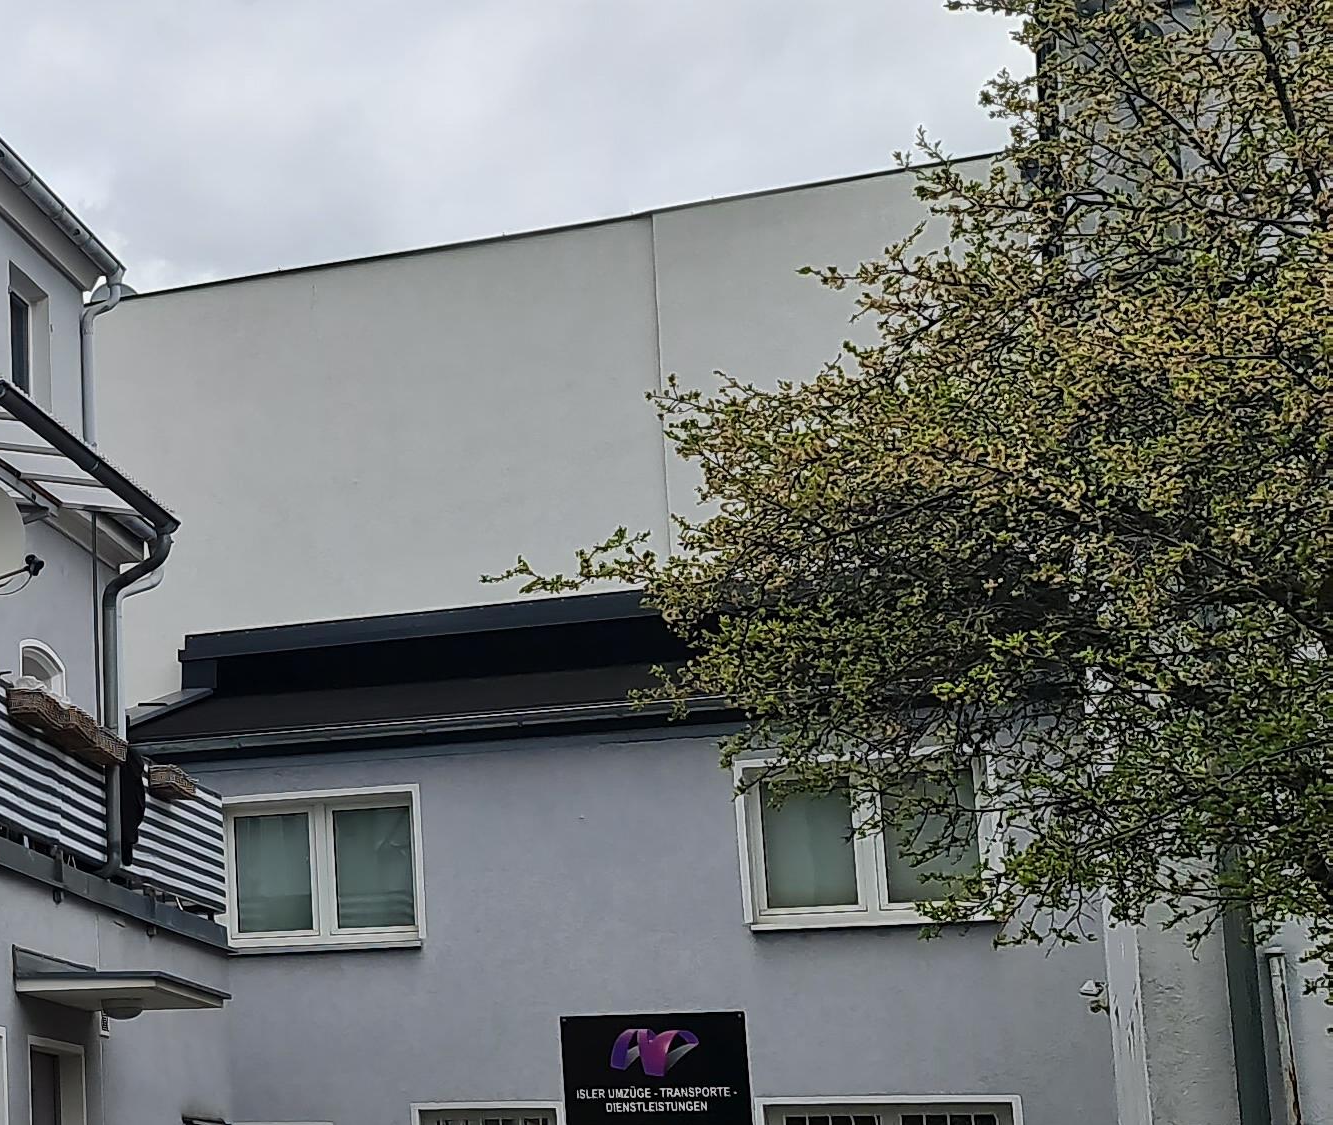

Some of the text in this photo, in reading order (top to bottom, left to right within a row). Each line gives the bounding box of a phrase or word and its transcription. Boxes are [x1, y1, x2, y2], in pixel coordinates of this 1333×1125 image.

[577, 1089, 605, 1099] ISLER
[608, 1086, 651, 1098] UMZÜGE
[659, 1087, 731, 1098] TRANSPORTE
[606, 1101, 708, 1113] DIENSTLEISTUNGEN
